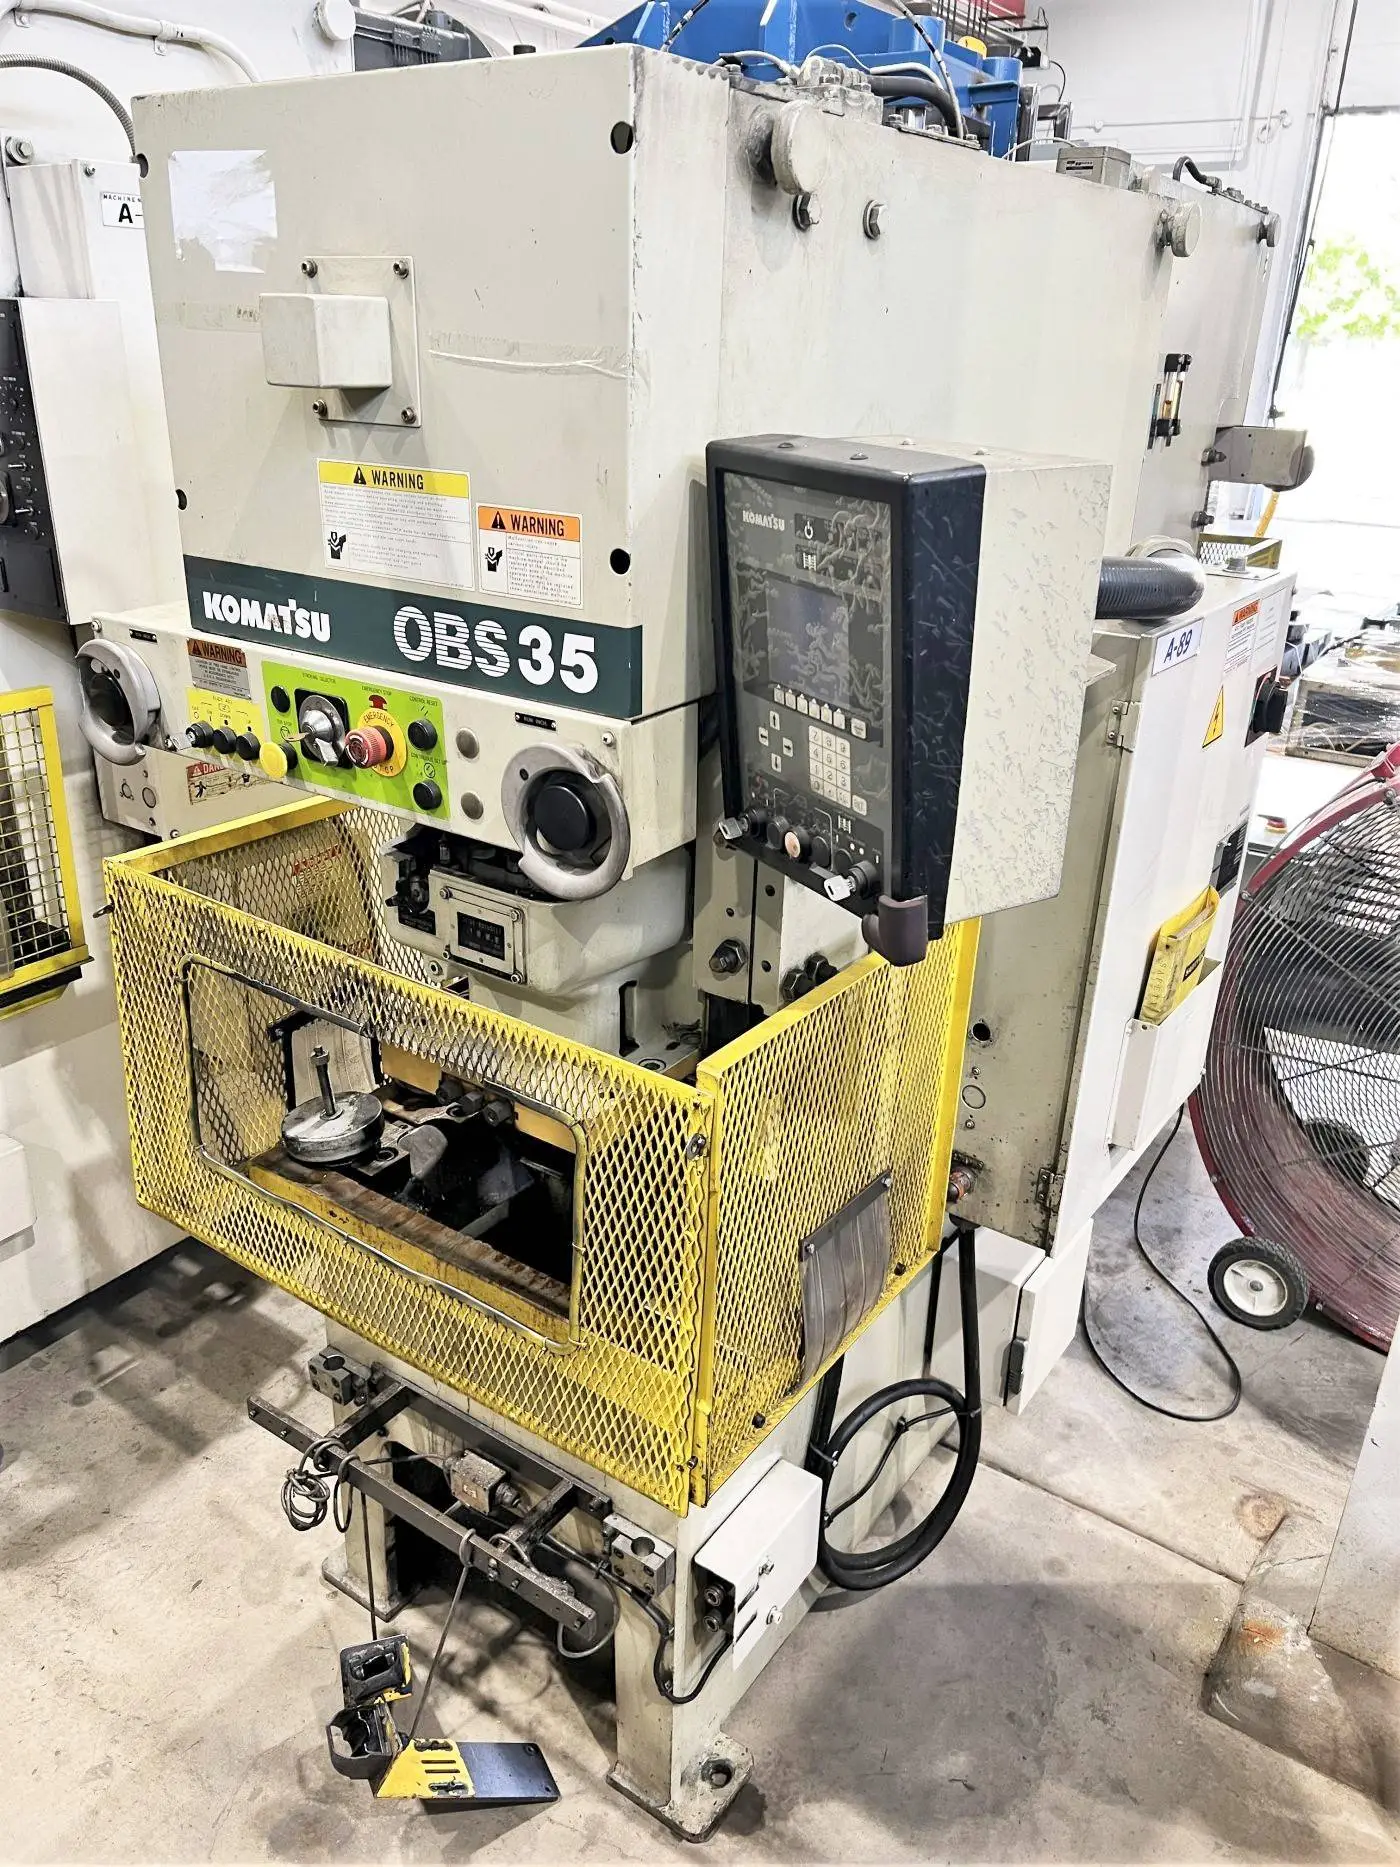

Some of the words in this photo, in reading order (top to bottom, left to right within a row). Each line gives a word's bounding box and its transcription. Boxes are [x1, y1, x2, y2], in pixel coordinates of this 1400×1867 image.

[371, 469, 424, 490] WARNING
[510, 514, 564, 536] WARNING
[742, 510, 785, 532] KOMATSU
[202, 591, 331, 642] KOMATSU
[202, 642, 242, 664] WARNING
[1164, 629, 1192, 664] A-89
[364, 710, 395, 727] EMERGENCY
